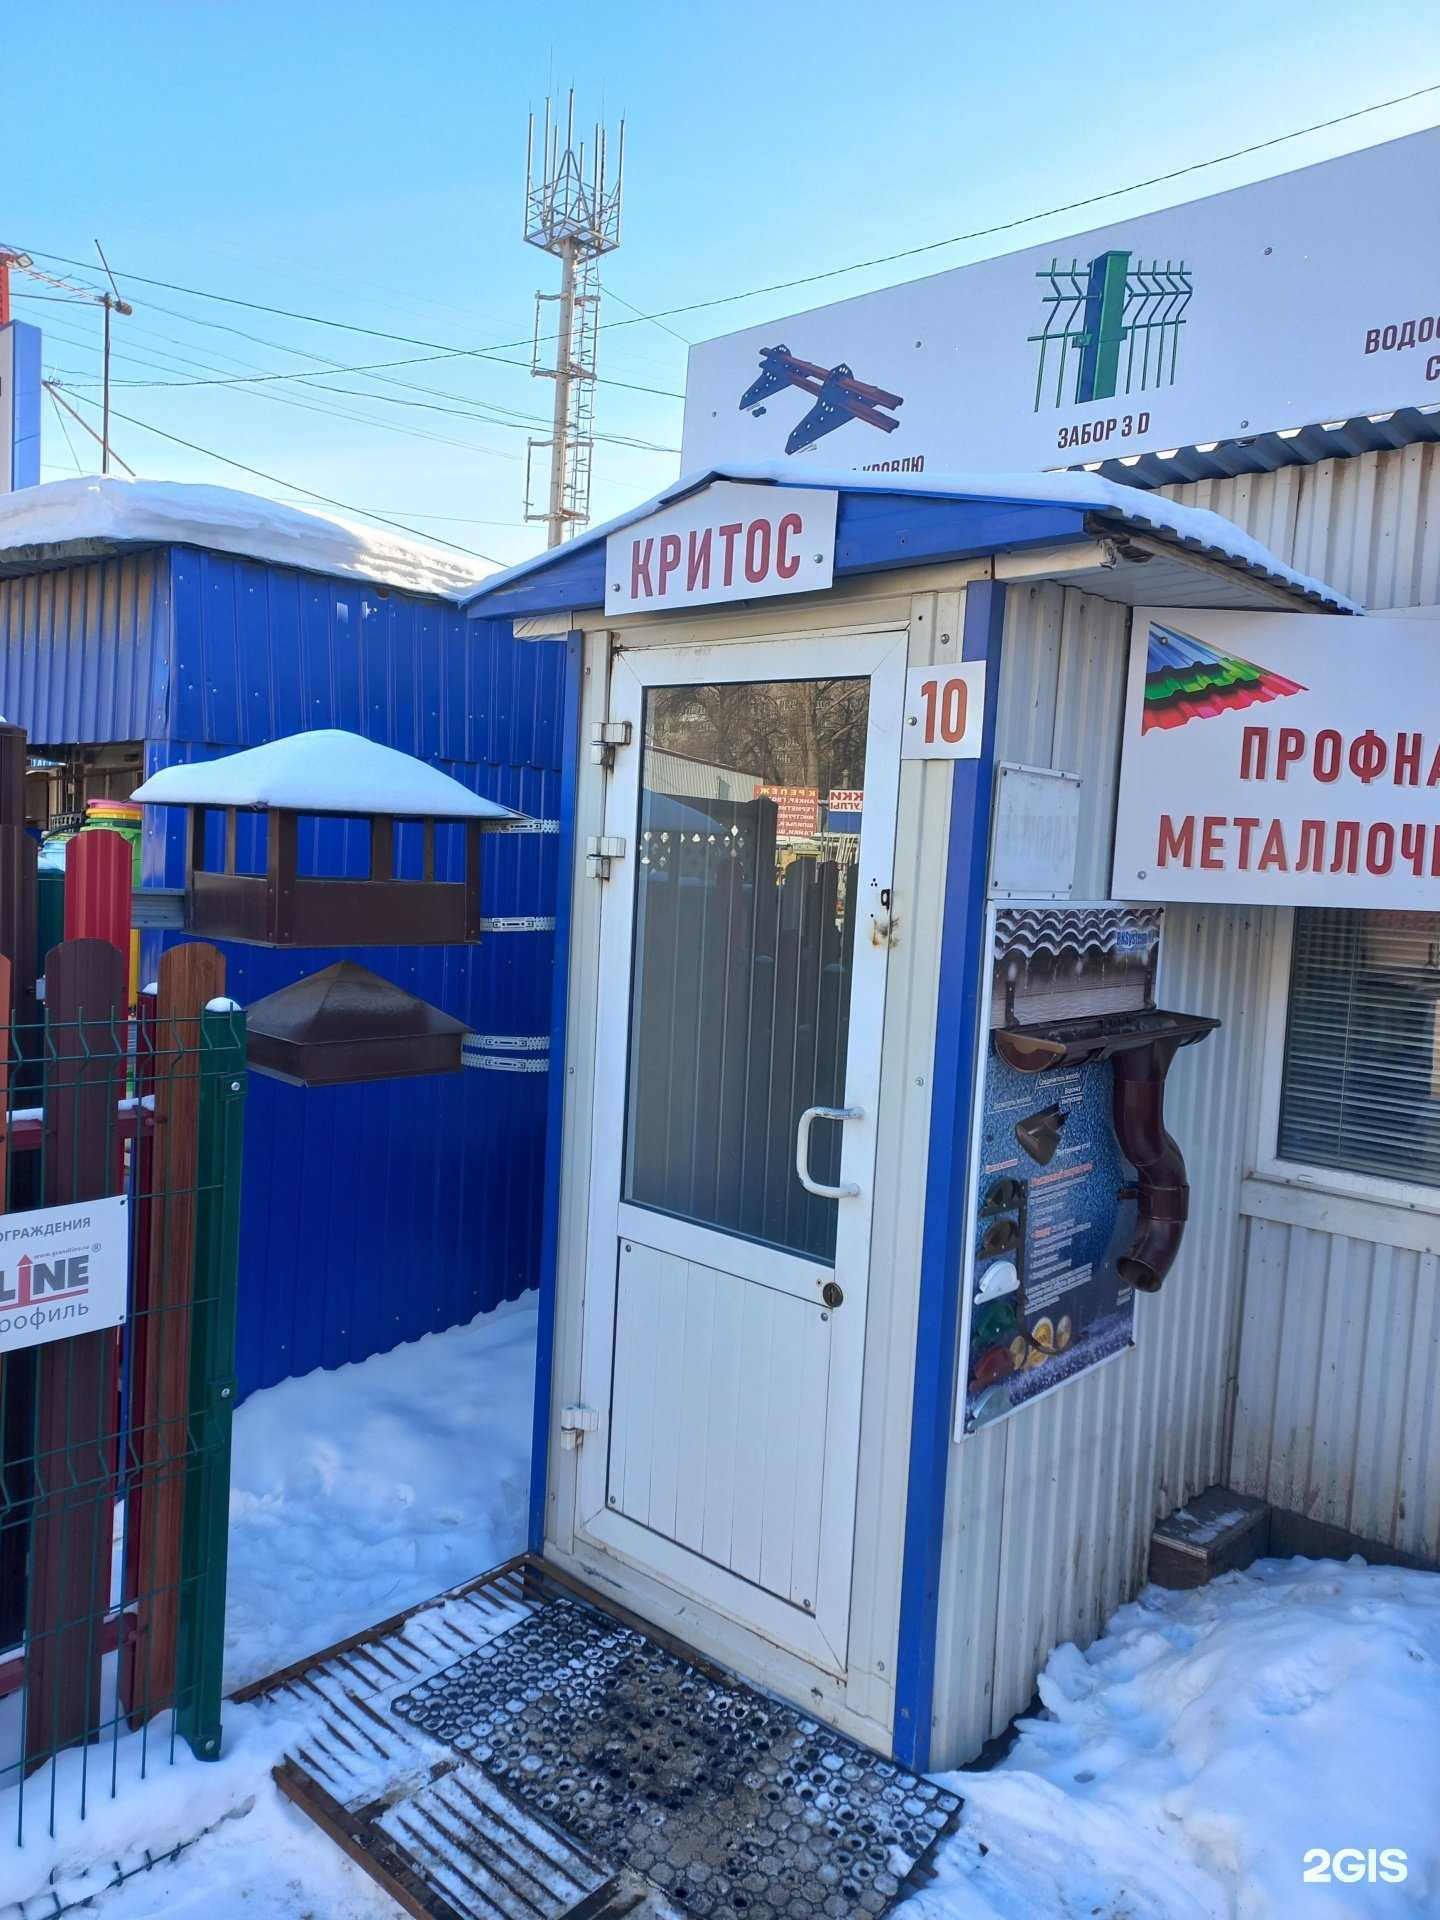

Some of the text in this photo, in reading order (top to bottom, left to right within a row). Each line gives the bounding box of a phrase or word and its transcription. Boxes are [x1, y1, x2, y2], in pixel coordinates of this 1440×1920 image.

[1058, 418, 1117, 449] ЗАБОР
[631, 513, 803, 600] КРИТОС
[921, 678, 968, 744] 10
